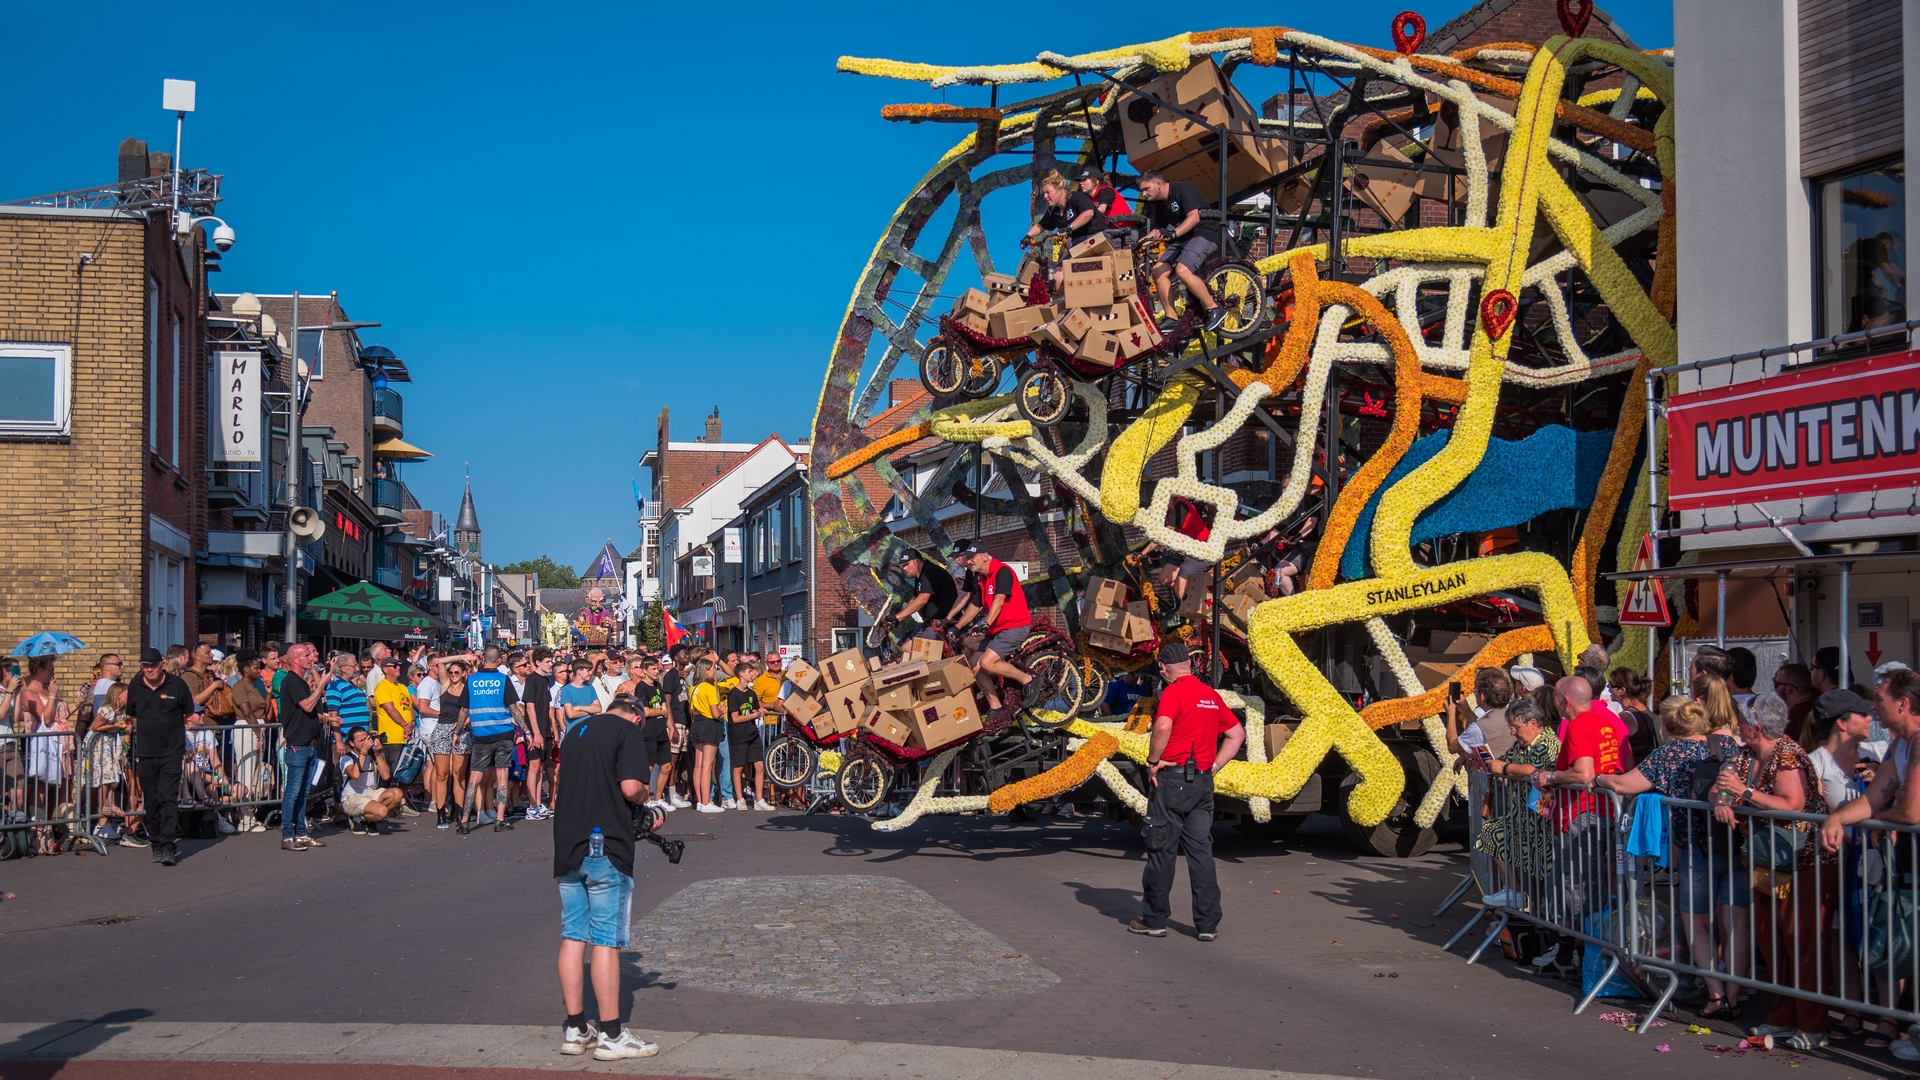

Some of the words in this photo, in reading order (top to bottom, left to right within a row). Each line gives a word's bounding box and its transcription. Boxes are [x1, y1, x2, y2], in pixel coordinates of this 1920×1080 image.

[231, 358, 247, 444] MARLO
[1366, 572, 1467, 606] STANLEYLAAN
[297, 609, 431, 627] eineken
[1859, 615, 1876, 623] PIN
[472, 680, 501, 688] corso
